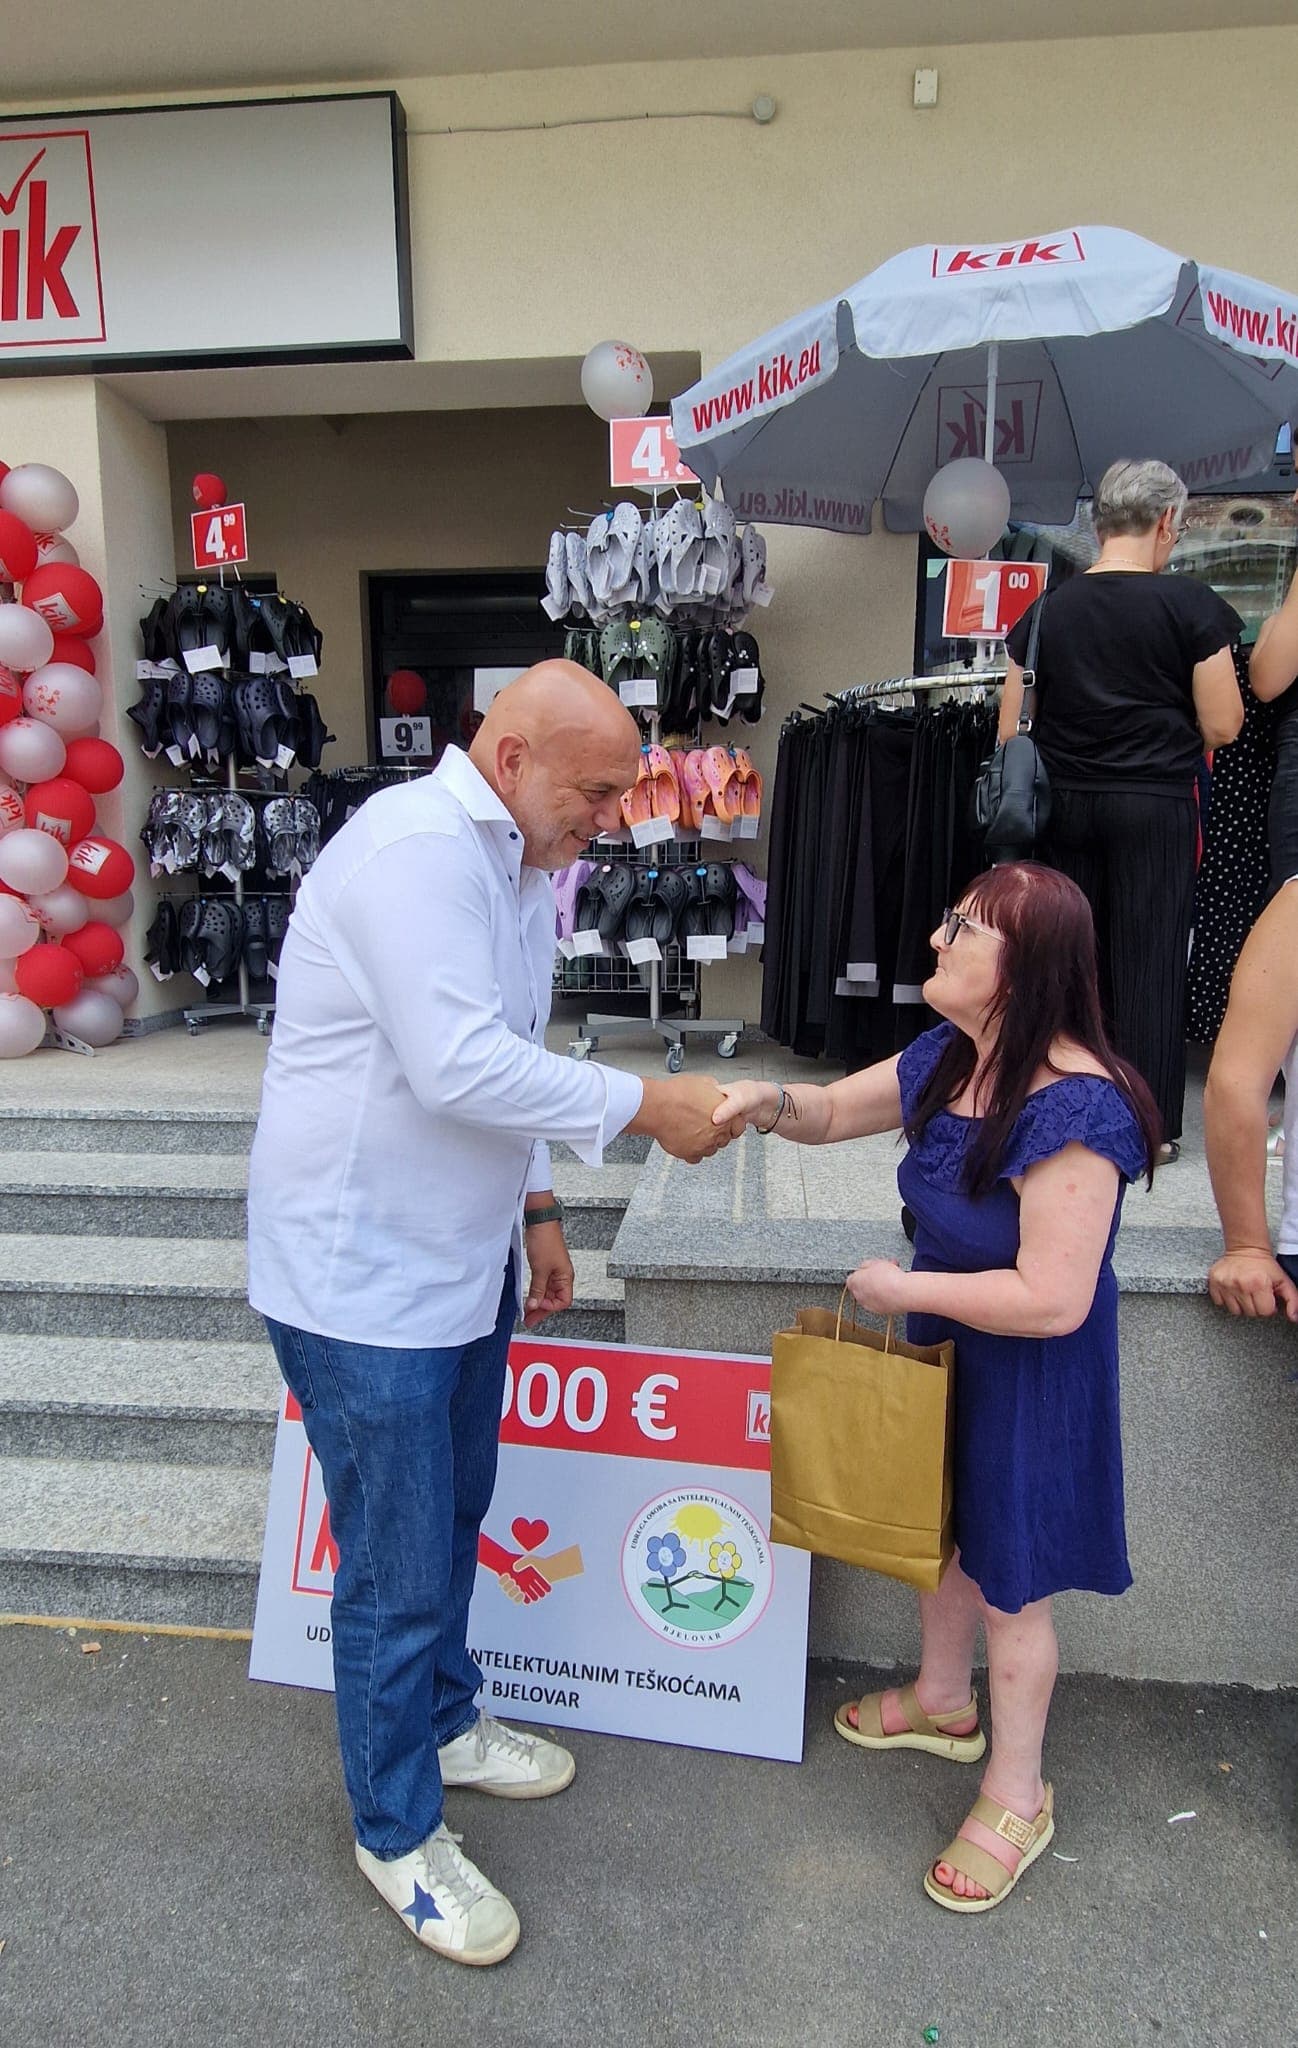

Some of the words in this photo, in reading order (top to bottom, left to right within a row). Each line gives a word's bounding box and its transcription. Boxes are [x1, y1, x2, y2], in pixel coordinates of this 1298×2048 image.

[0, 150, 82, 321] ik
[947, 243, 1067, 272] kik
[1208, 290, 1298, 357] www.ki
[692, 340, 821, 433] www.kik.eu
[74, 842, 99, 865] kik
[500, 1361, 608, 1433] 00
[631, 1373, 679, 1441] €
[631, 1519, 648, 1549] UDRUGA
[646, 1502, 668, 1520] OSOBA
[677, 1493, 742, 1521] INTELEKTUALNIM
[306, 1625, 332, 1642] UD
[625, 1668, 741, 1703] TEŠKOĆAMA
[663, 1625, 722, 1642] BJELOVAR
[491, 1679, 580, 1709] BJELOVAR
